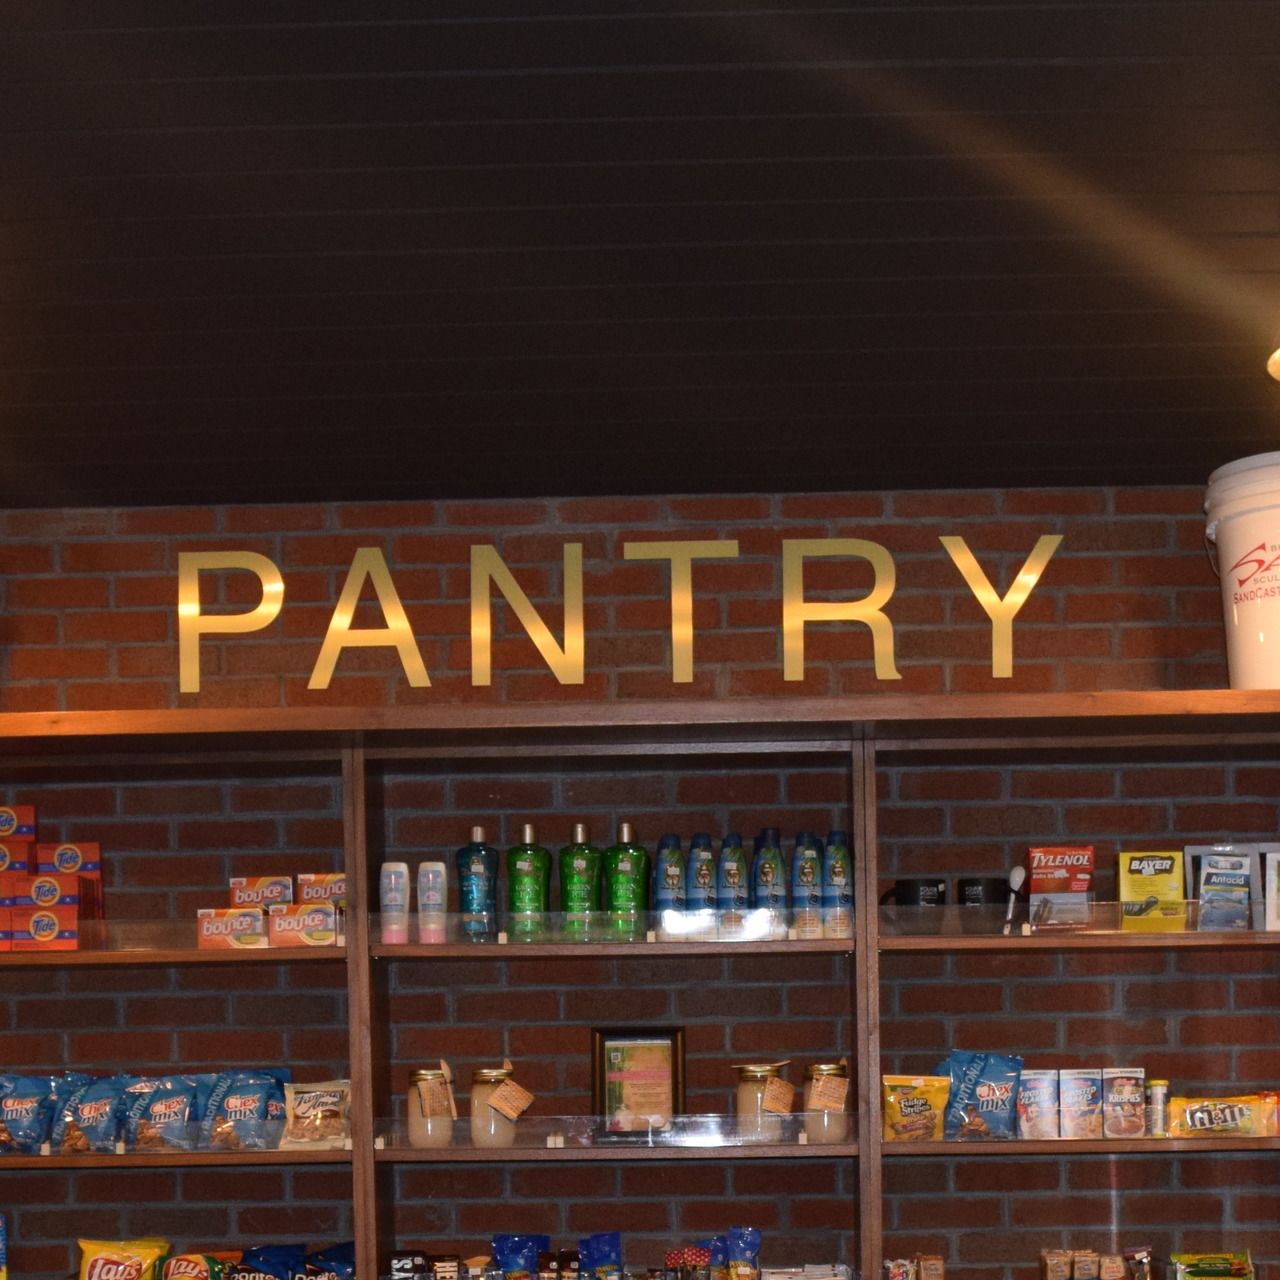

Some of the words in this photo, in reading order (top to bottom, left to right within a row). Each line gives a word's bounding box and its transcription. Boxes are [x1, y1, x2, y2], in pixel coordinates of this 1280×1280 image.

[177, 532, 1064, 693] PANTRY
[56, 851, 80, 865] Tide
[1031, 853, 1091, 868] TYLENOL
[1130, 859, 1173, 871] BAYER
[1210, 875, 1245, 885] Antacid
[34, 884, 58, 899] Tide
[235, 885, 282, 905] bounce
[32, 919, 56, 934] Tide
[202, 915, 252, 935] bounce
[275, 912, 324, 932] bounce
[267, 1102, 282, 1114] ex
[978, 1096, 1012, 1112] mix
